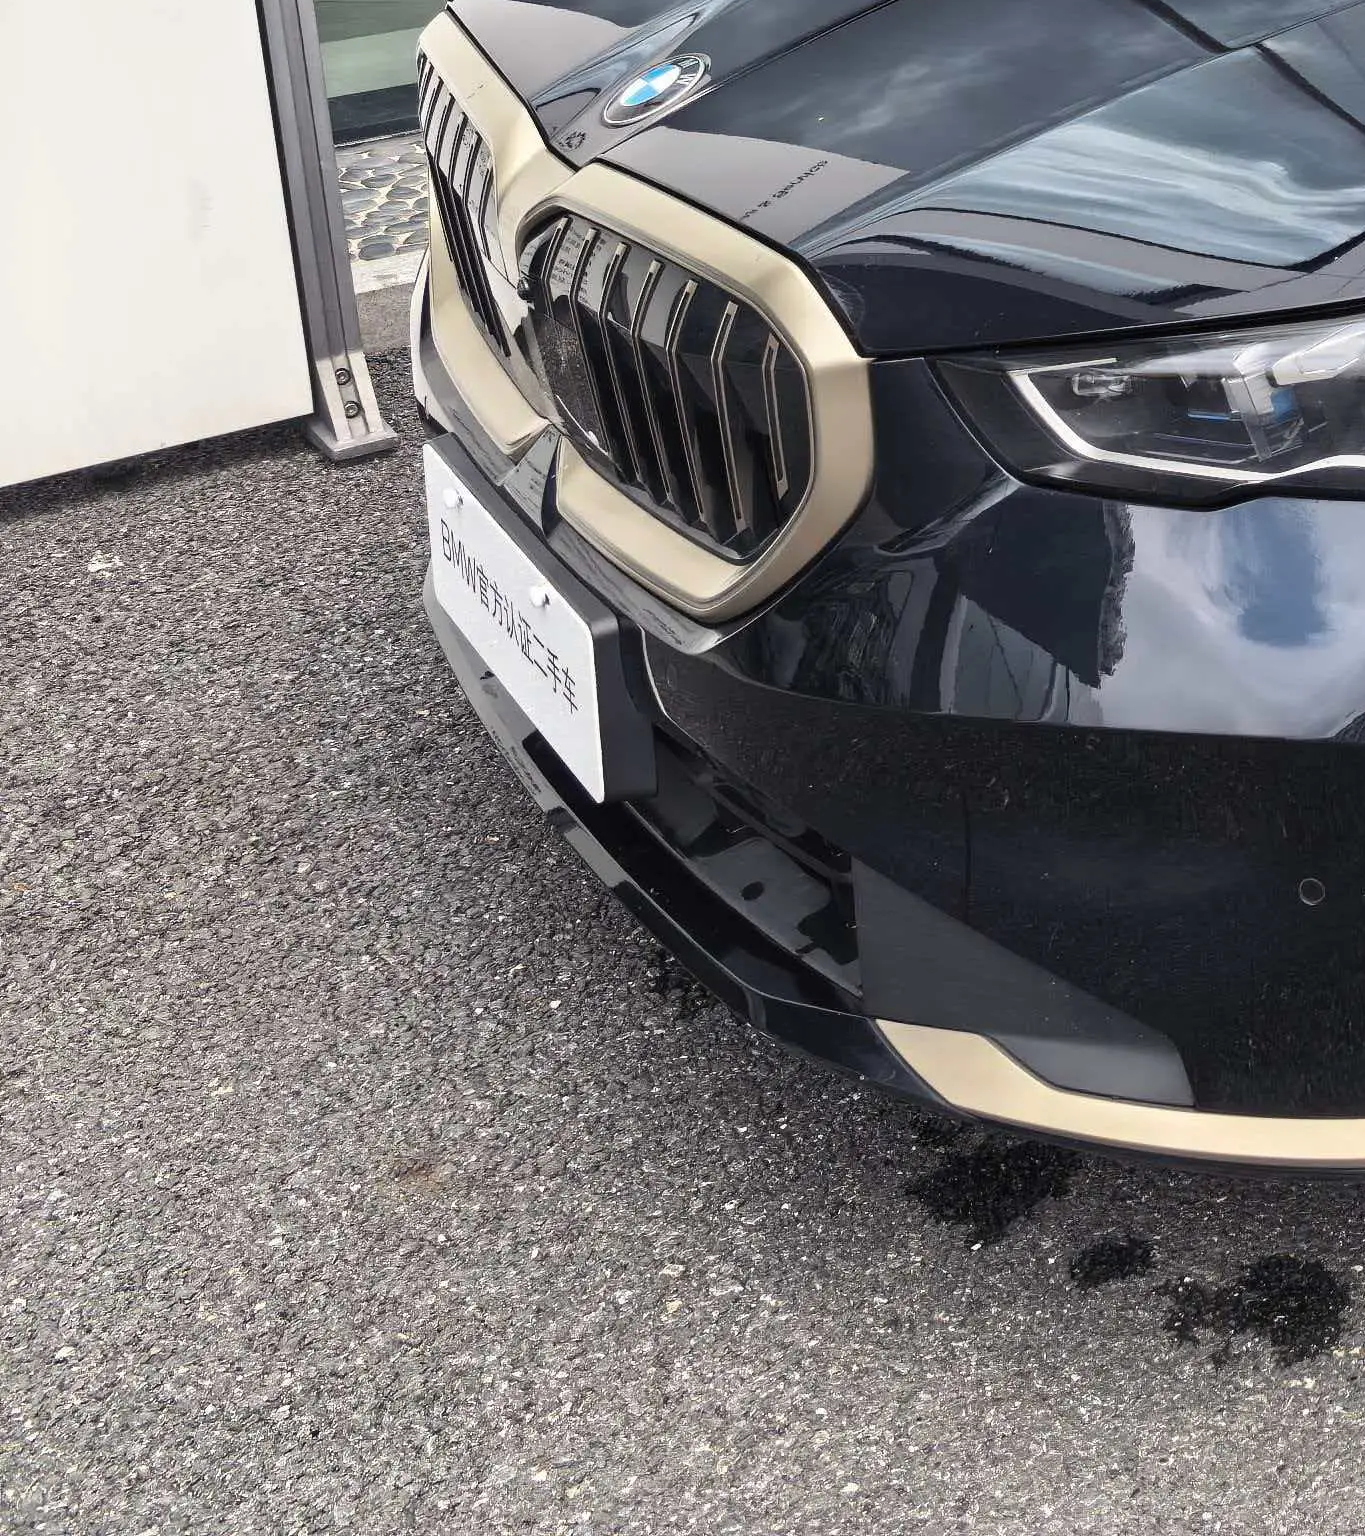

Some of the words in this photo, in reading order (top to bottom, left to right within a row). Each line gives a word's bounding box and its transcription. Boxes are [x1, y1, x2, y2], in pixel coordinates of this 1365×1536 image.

[440, 518, 578, 715] BMW官方认证二手车
